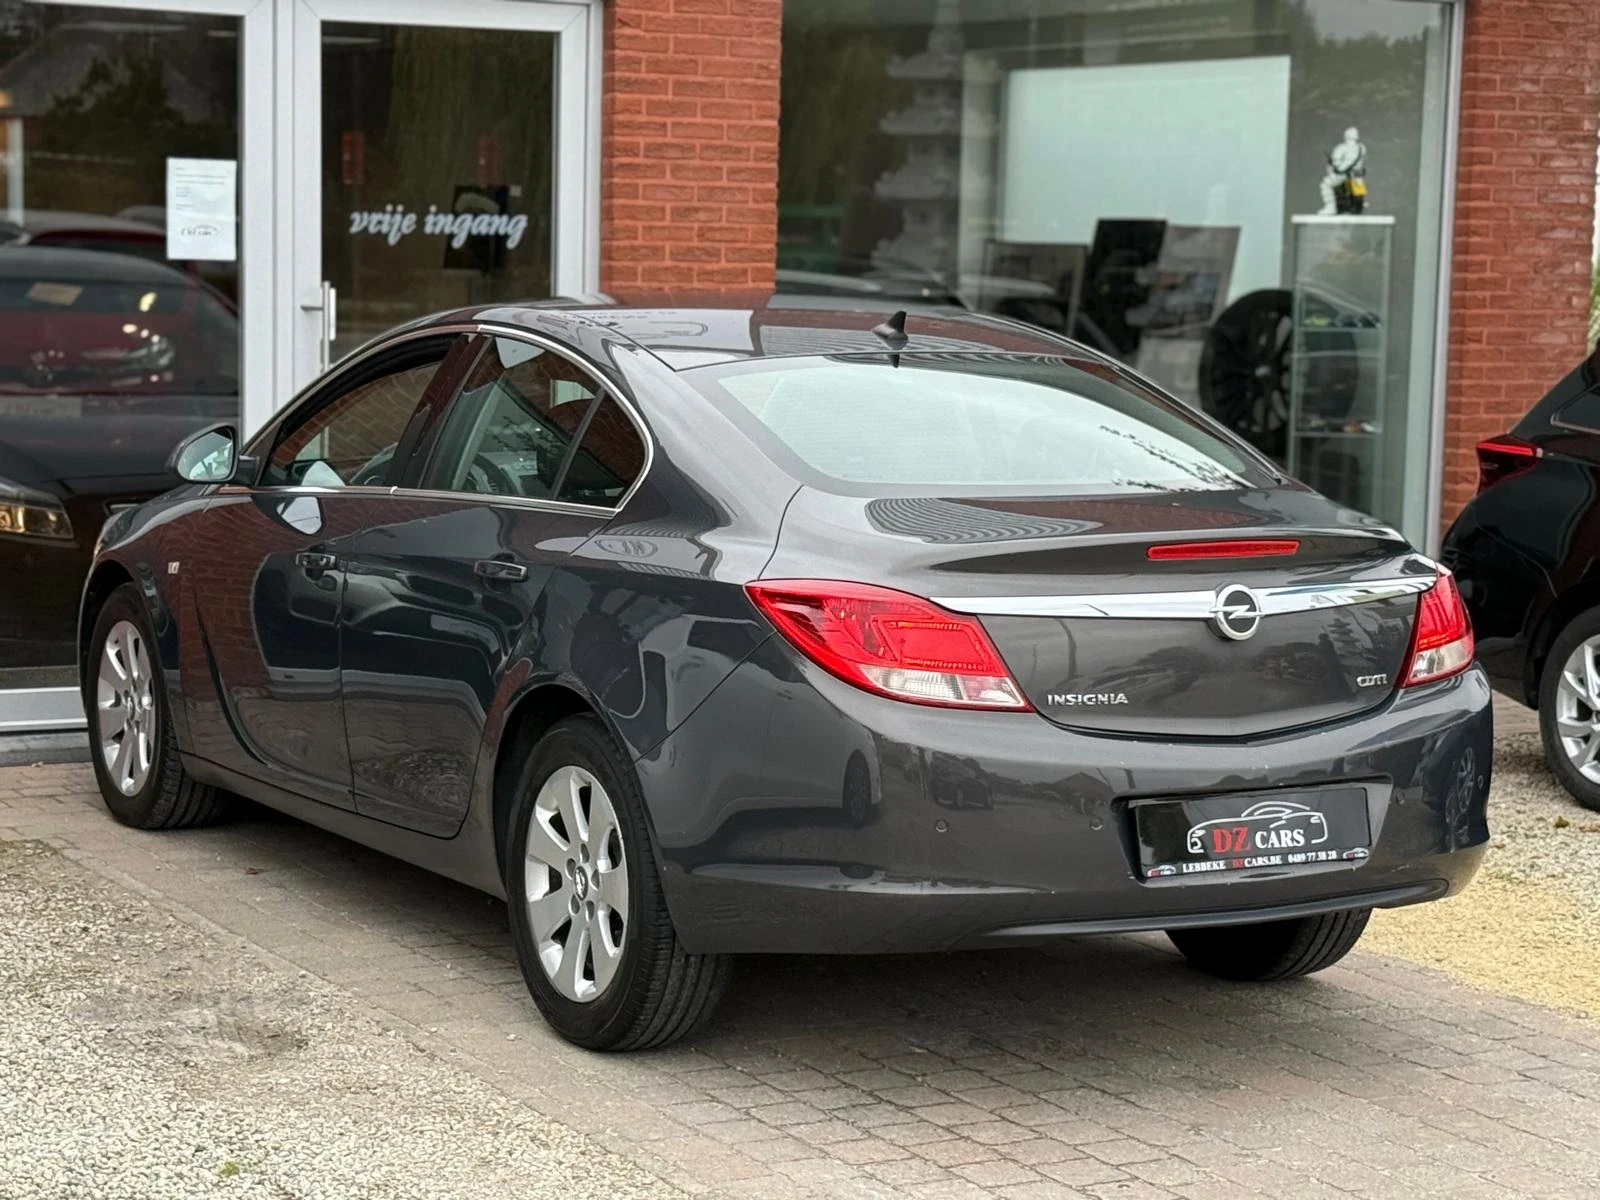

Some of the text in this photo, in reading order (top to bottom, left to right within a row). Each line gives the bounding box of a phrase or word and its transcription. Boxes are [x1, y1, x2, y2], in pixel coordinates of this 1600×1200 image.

[349, 204, 529, 249] vrije ingang
[1047, 692, 1129, 706] INSIGNIA
[1213, 826, 1305, 854] DZ CARS
[1182, 860, 1227, 873] LEBBEKE
